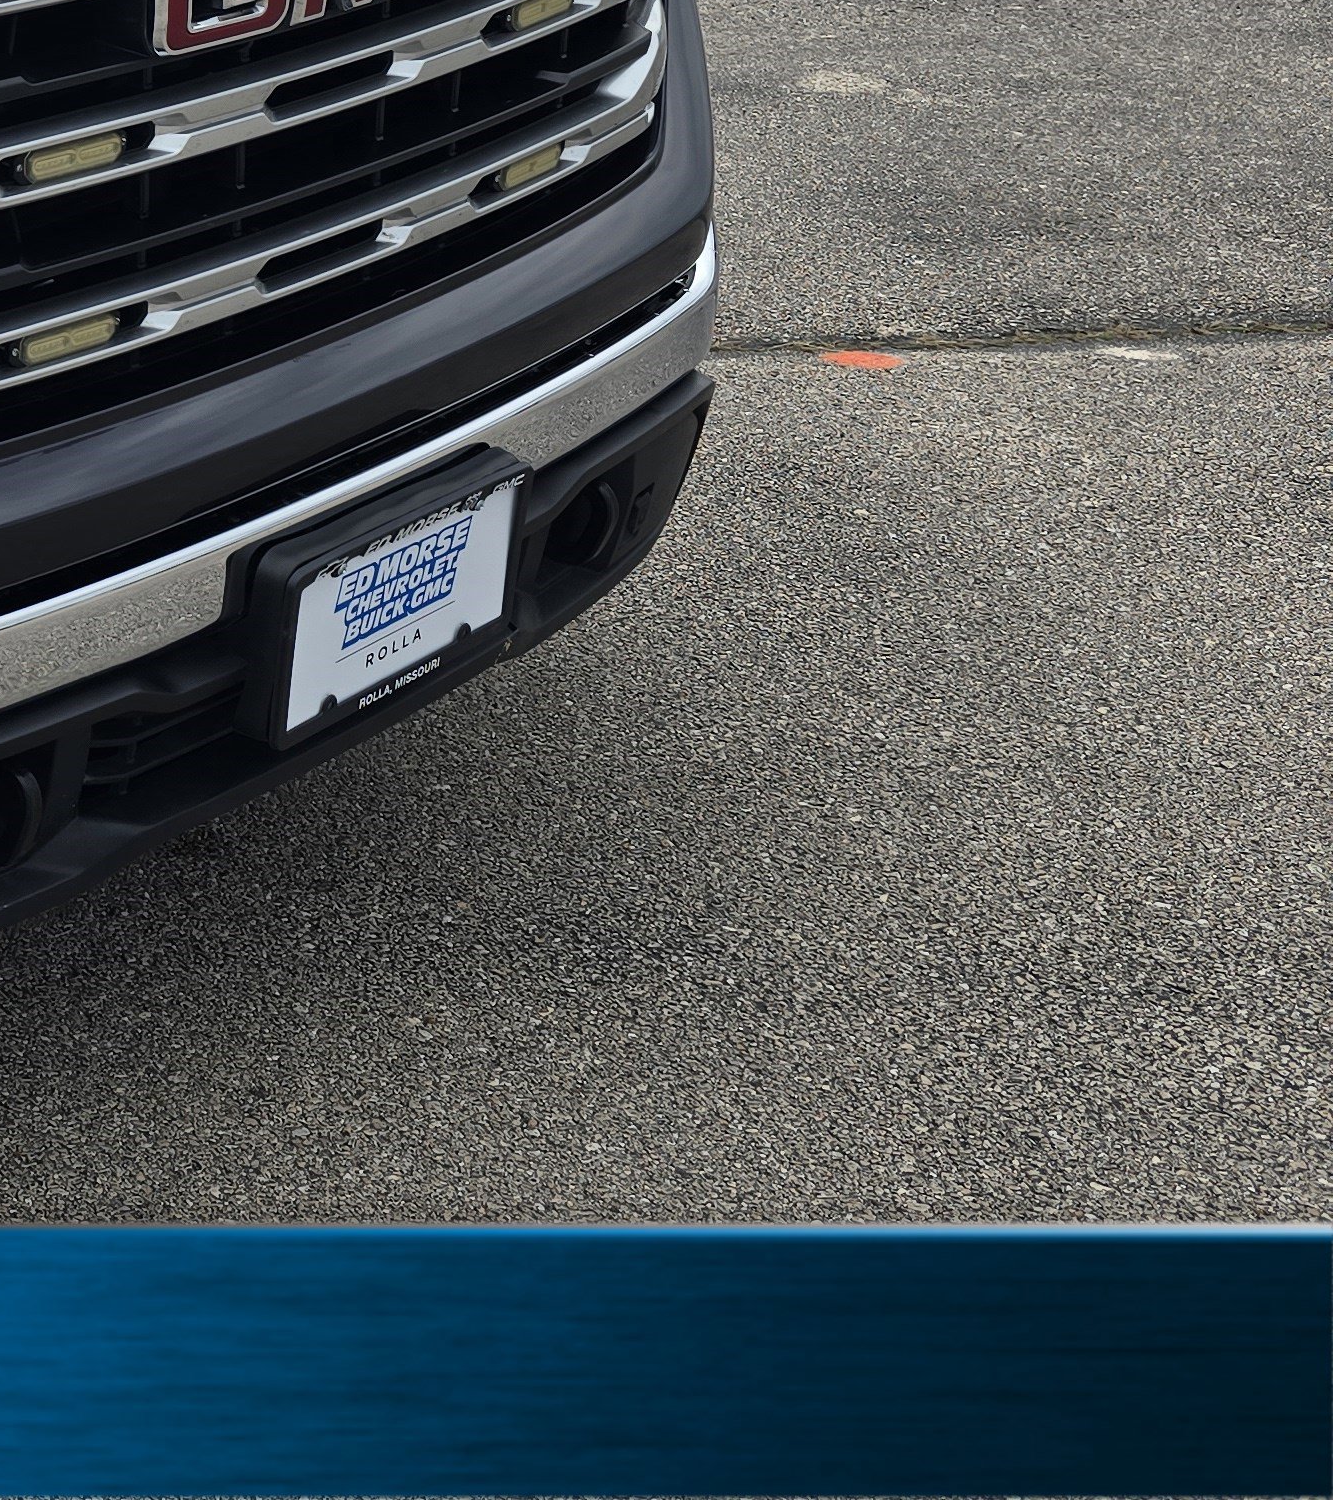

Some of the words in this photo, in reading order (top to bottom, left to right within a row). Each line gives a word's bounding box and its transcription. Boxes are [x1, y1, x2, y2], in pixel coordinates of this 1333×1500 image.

[392, 501, 463, 544] MORSE
[493, 473, 526, 494] GMC
[336, 564, 376, 606] ED
[375, 516, 471, 587] MORSE
[345, 551, 459, 621] CHEVROLET
[364, 628, 423, 668] ROLLA
[358, 682, 393, 711] ROLLA,
[394, 656, 442, 690] MISSOURI
